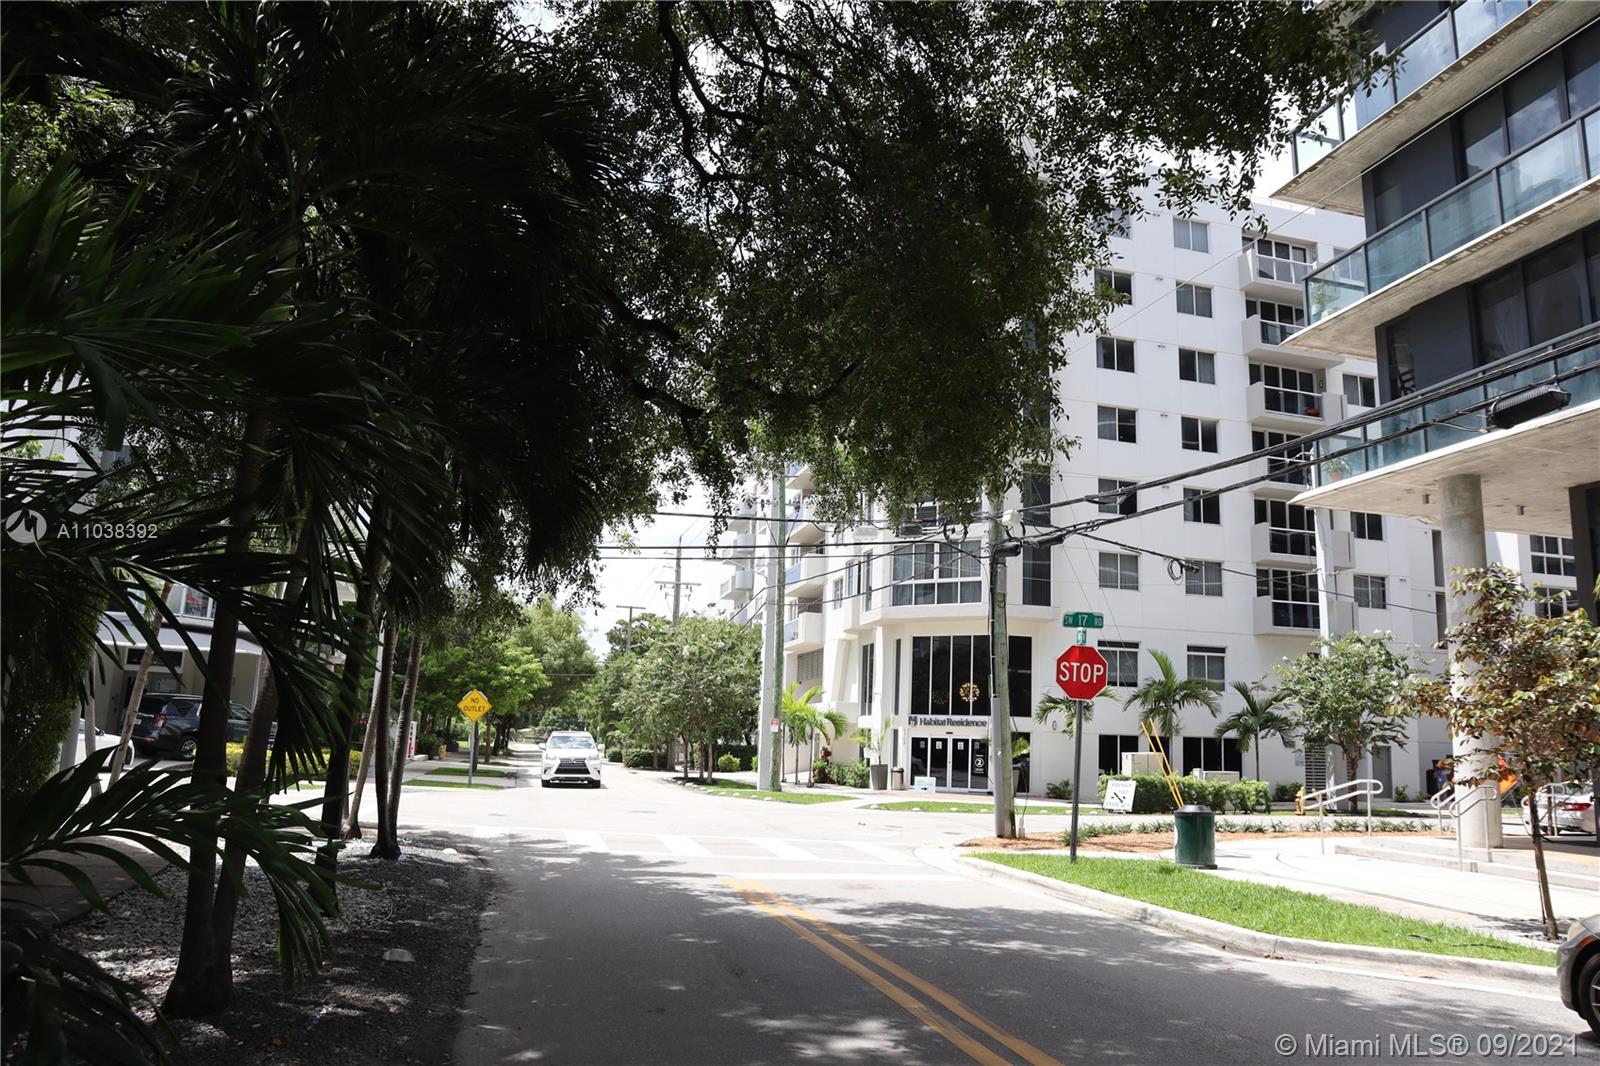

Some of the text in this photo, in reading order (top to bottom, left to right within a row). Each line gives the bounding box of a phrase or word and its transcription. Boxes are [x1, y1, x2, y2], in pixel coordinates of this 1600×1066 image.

[1078, 614, 1088, 626] 17
[1059, 661, 1104, 684] STOP
[919, 717, 946, 726] Habitat
